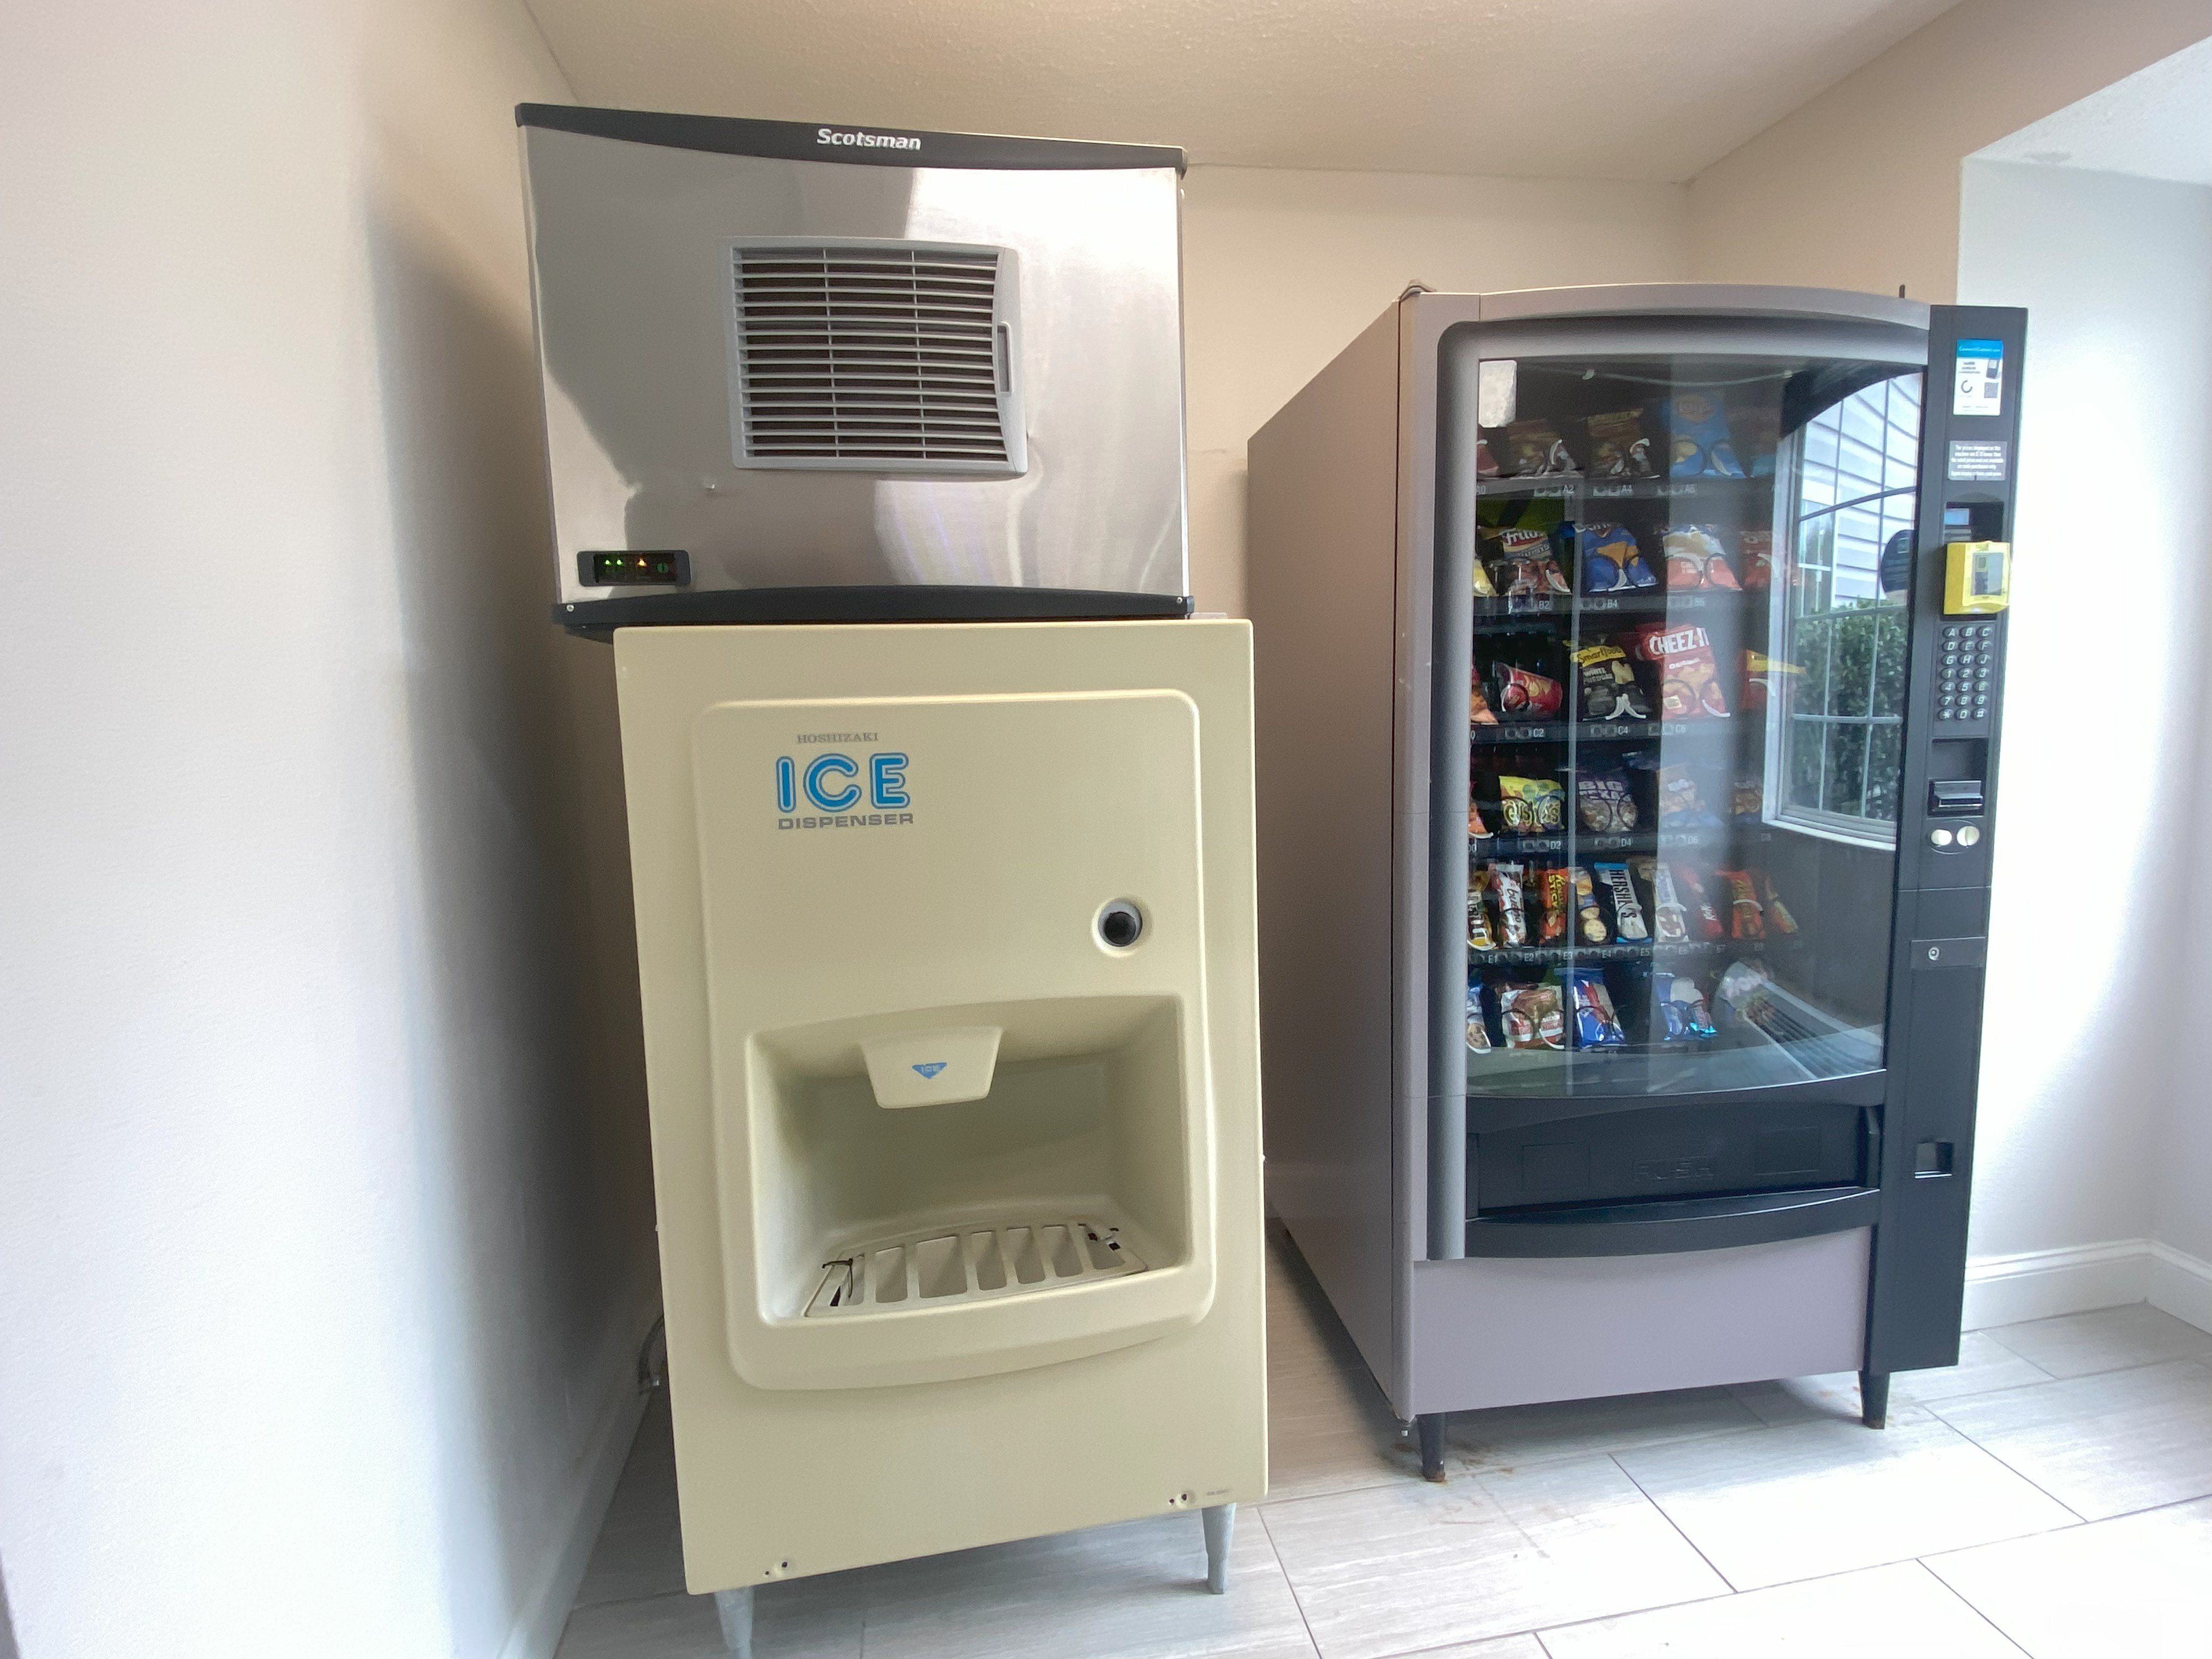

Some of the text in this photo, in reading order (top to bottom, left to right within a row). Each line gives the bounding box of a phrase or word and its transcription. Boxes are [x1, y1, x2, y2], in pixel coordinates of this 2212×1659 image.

[816, 128, 921, 151] Scotsman
[797, 732, 879, 744] HOSHIZAKI
[1533, 728, 1544, 738] C2
[776, 752, 911, 814] ICE
[1578, 781, 1623, 791] BIG
[778, 813, 914, 830] DISPENSER
[1550, 841, 1561, 850] D2
